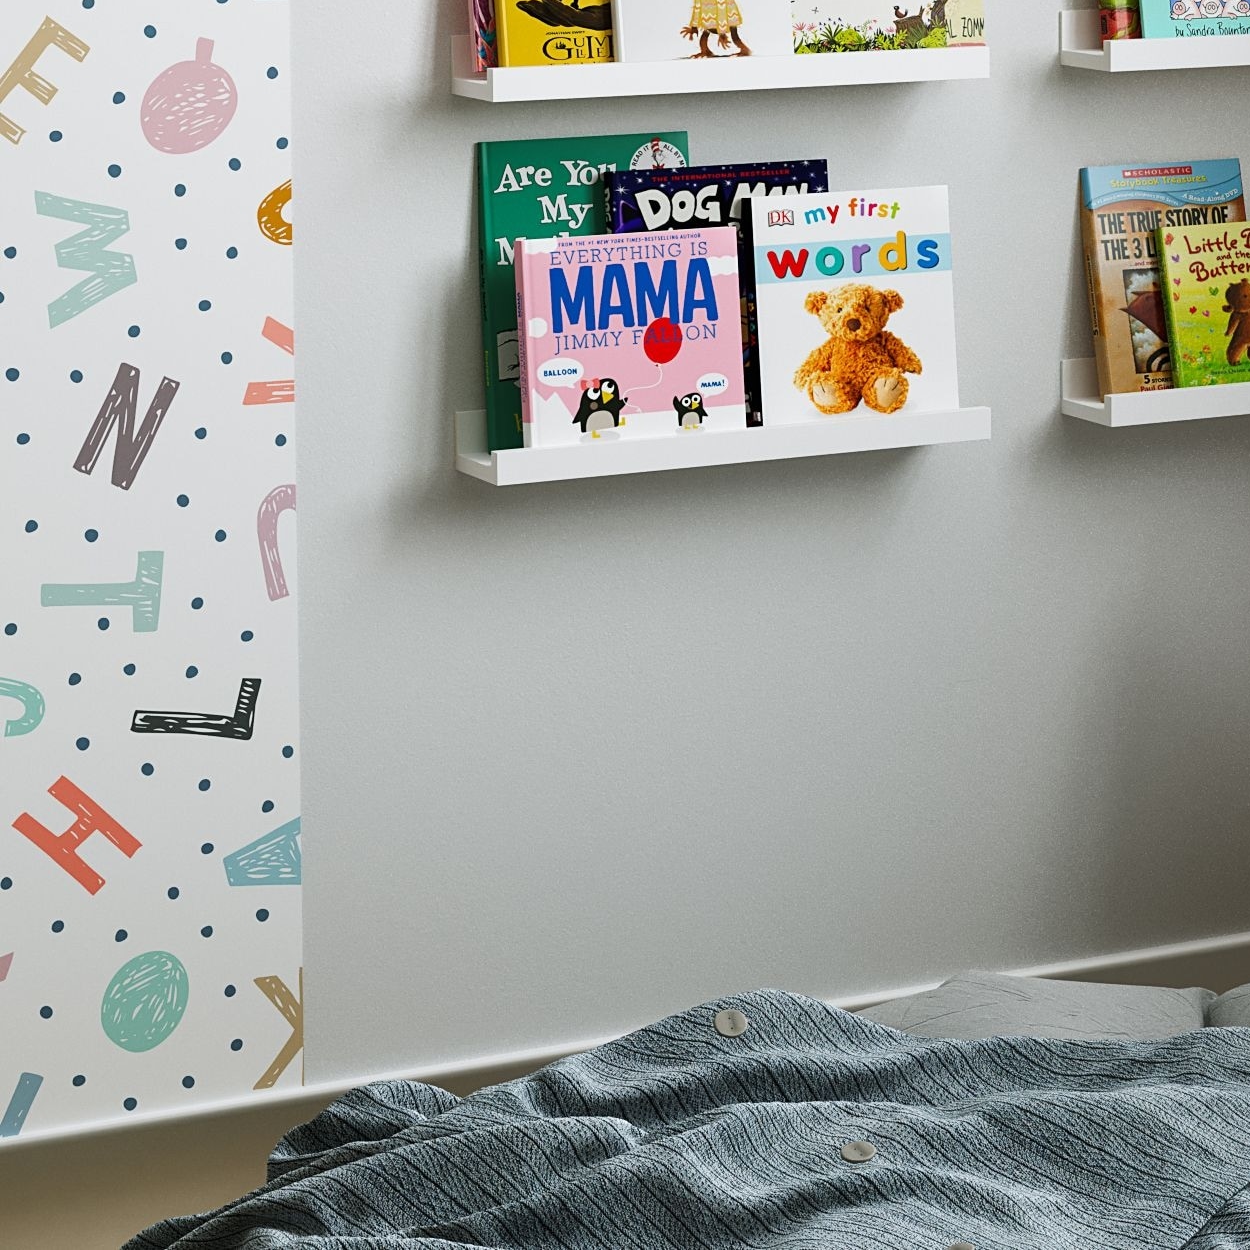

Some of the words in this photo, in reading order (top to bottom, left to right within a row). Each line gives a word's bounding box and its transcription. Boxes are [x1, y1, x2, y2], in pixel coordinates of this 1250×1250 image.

[493, 163, 553, 194] Are
[1131, 166, 1192, 177] SCHOLASTIC
[537, 194, 593, 230] My
[635, 184, 722, 230] DOG
[769, 211, 793, 226] DK
[804, 204, 840, 226] my
[848, 197, 901, 220] first
[1097, 212, 1126, 235] THE
[1126, 210, 1163, 233] TRUE
[1165, 206, 1210, 227] STORY
[1211, 205, 1229, 224] OF
[549, 243, 682, 266] EVERYTHING
[691, 241, 708, 255] IS
[767, 230, 940, 280] words
[1101, 238, 1130, 262] THE
[1133, 237, 1143, 259] 3
[1184, 231, 1237, 255] Little
[1216, 253, 1231, 261] and
[1235, 250, 1250, 259] the
[548, 257, 719, 333] MAMA
[555, 331, 622, 355] JIMMY
[632, 323, 717, 345] FALLON
[543, 367, 578, 377] BALLOON
[700, 379, 725, 388] MAMA!
